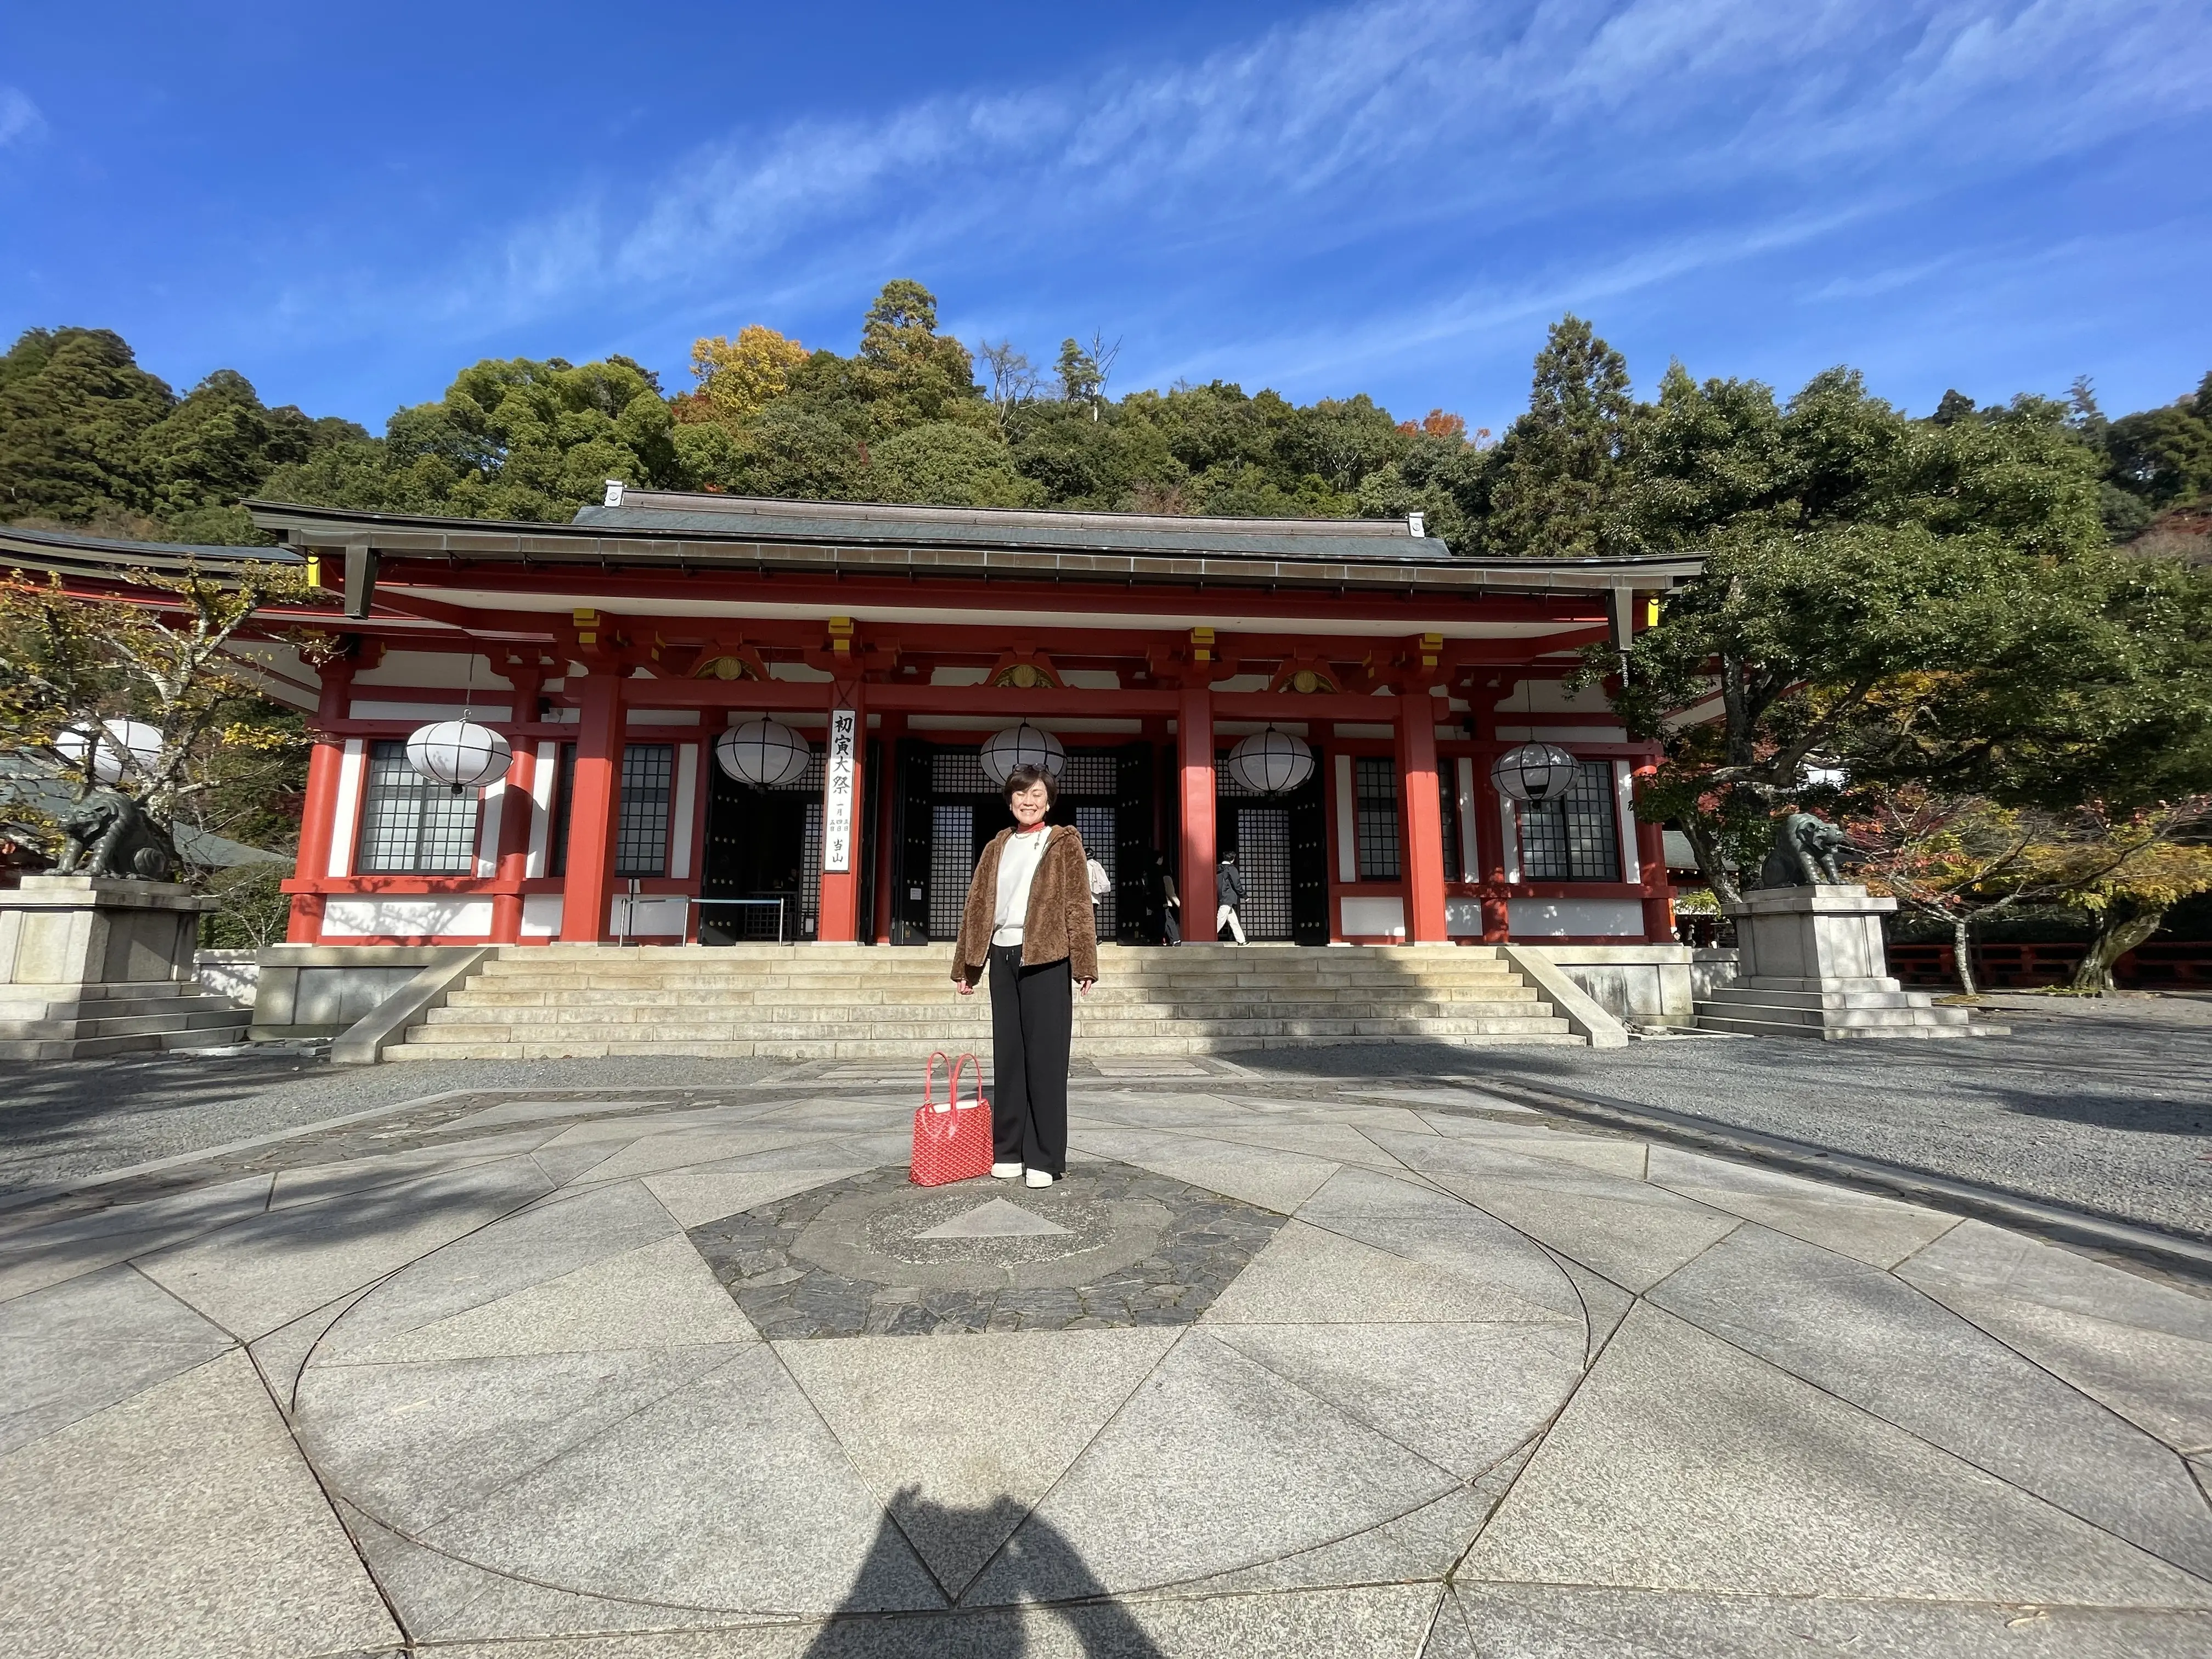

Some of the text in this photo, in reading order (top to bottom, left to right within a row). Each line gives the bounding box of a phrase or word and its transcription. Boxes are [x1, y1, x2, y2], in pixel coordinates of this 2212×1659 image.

[833, 715, 851, 794] 初寅大祭
[836, 803, 844, 816] 一月
[832, 838, 843, 863] 当山
